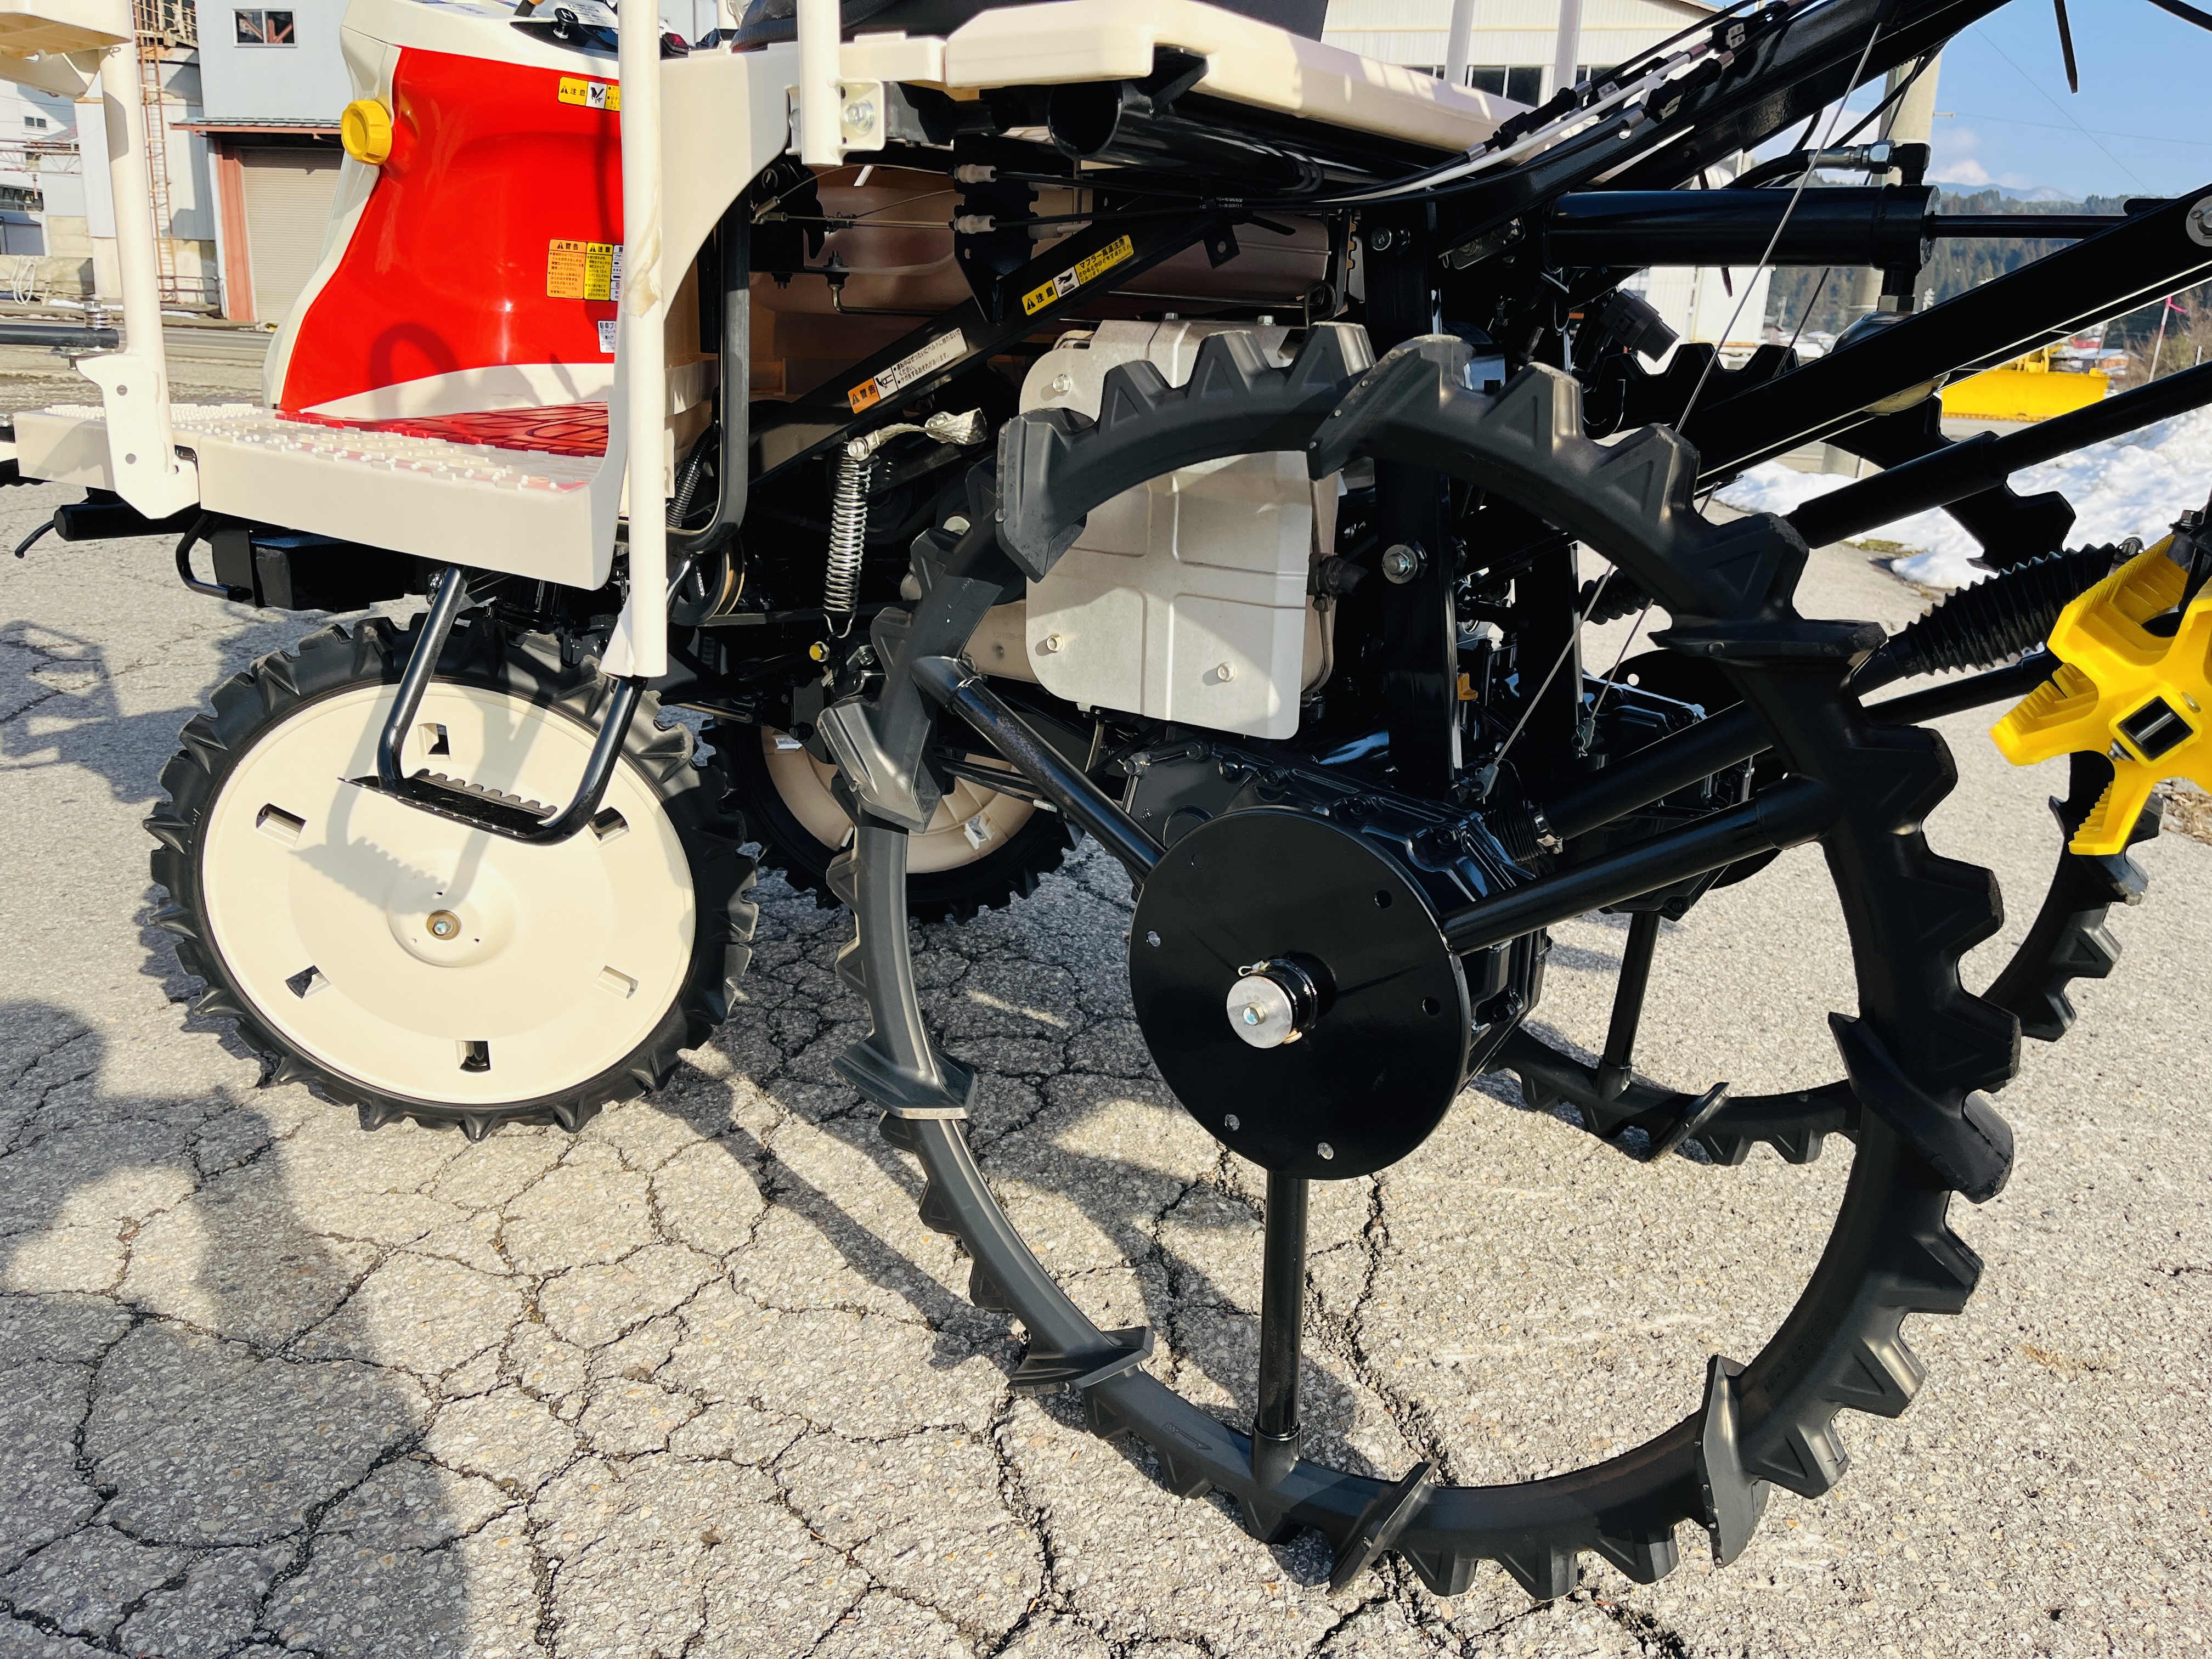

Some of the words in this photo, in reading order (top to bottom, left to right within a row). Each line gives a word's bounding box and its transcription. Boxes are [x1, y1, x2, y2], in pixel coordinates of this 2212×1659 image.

[561, 10, 574, 19] N
[570, 87, 585, 97] 注意
[1079, 238, 1125, 268] マフラー高温注意
[1036, 286, 1054, 303] 注意
[897, 329, 961, 370] 運転中はぜったいにベルトに触れないで
[899, 365, 915, 376] ください。
[901, 353, 949, 383] ケガをするおそれがあります。
[860, 385, 876, 399] 警告
